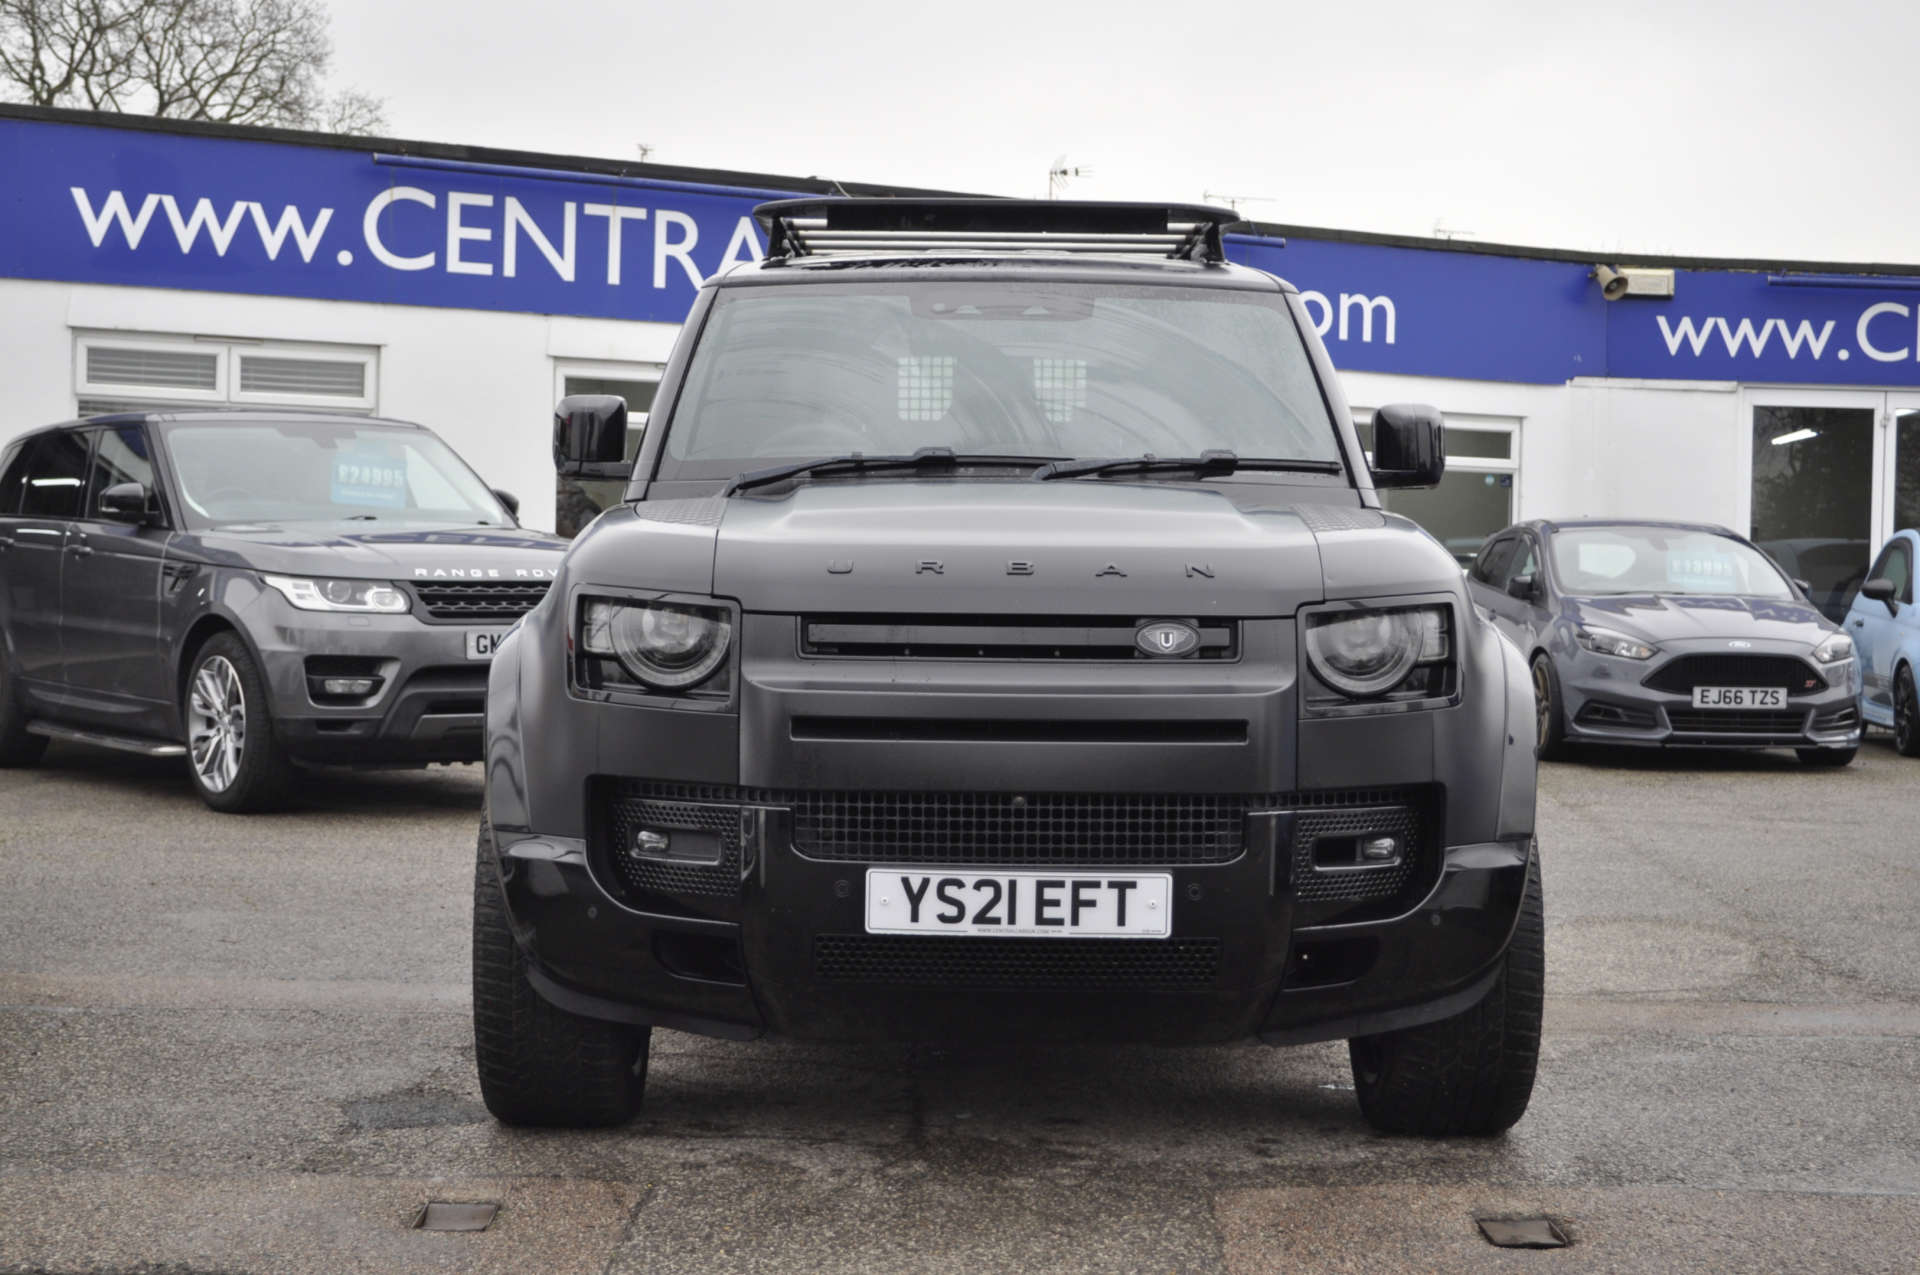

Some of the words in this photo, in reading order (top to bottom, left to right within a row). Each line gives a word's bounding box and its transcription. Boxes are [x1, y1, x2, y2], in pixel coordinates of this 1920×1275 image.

[414, 567, 500, 577] RANGE
[826, 559, 1215, 578] URBAN
[1700, 688, 1744, 705] EJ66
[1748, 689, 1780, 706] TZS
[901, 875, 1017, 925] YS21
[1035, 880, 1137, 928] EFT
